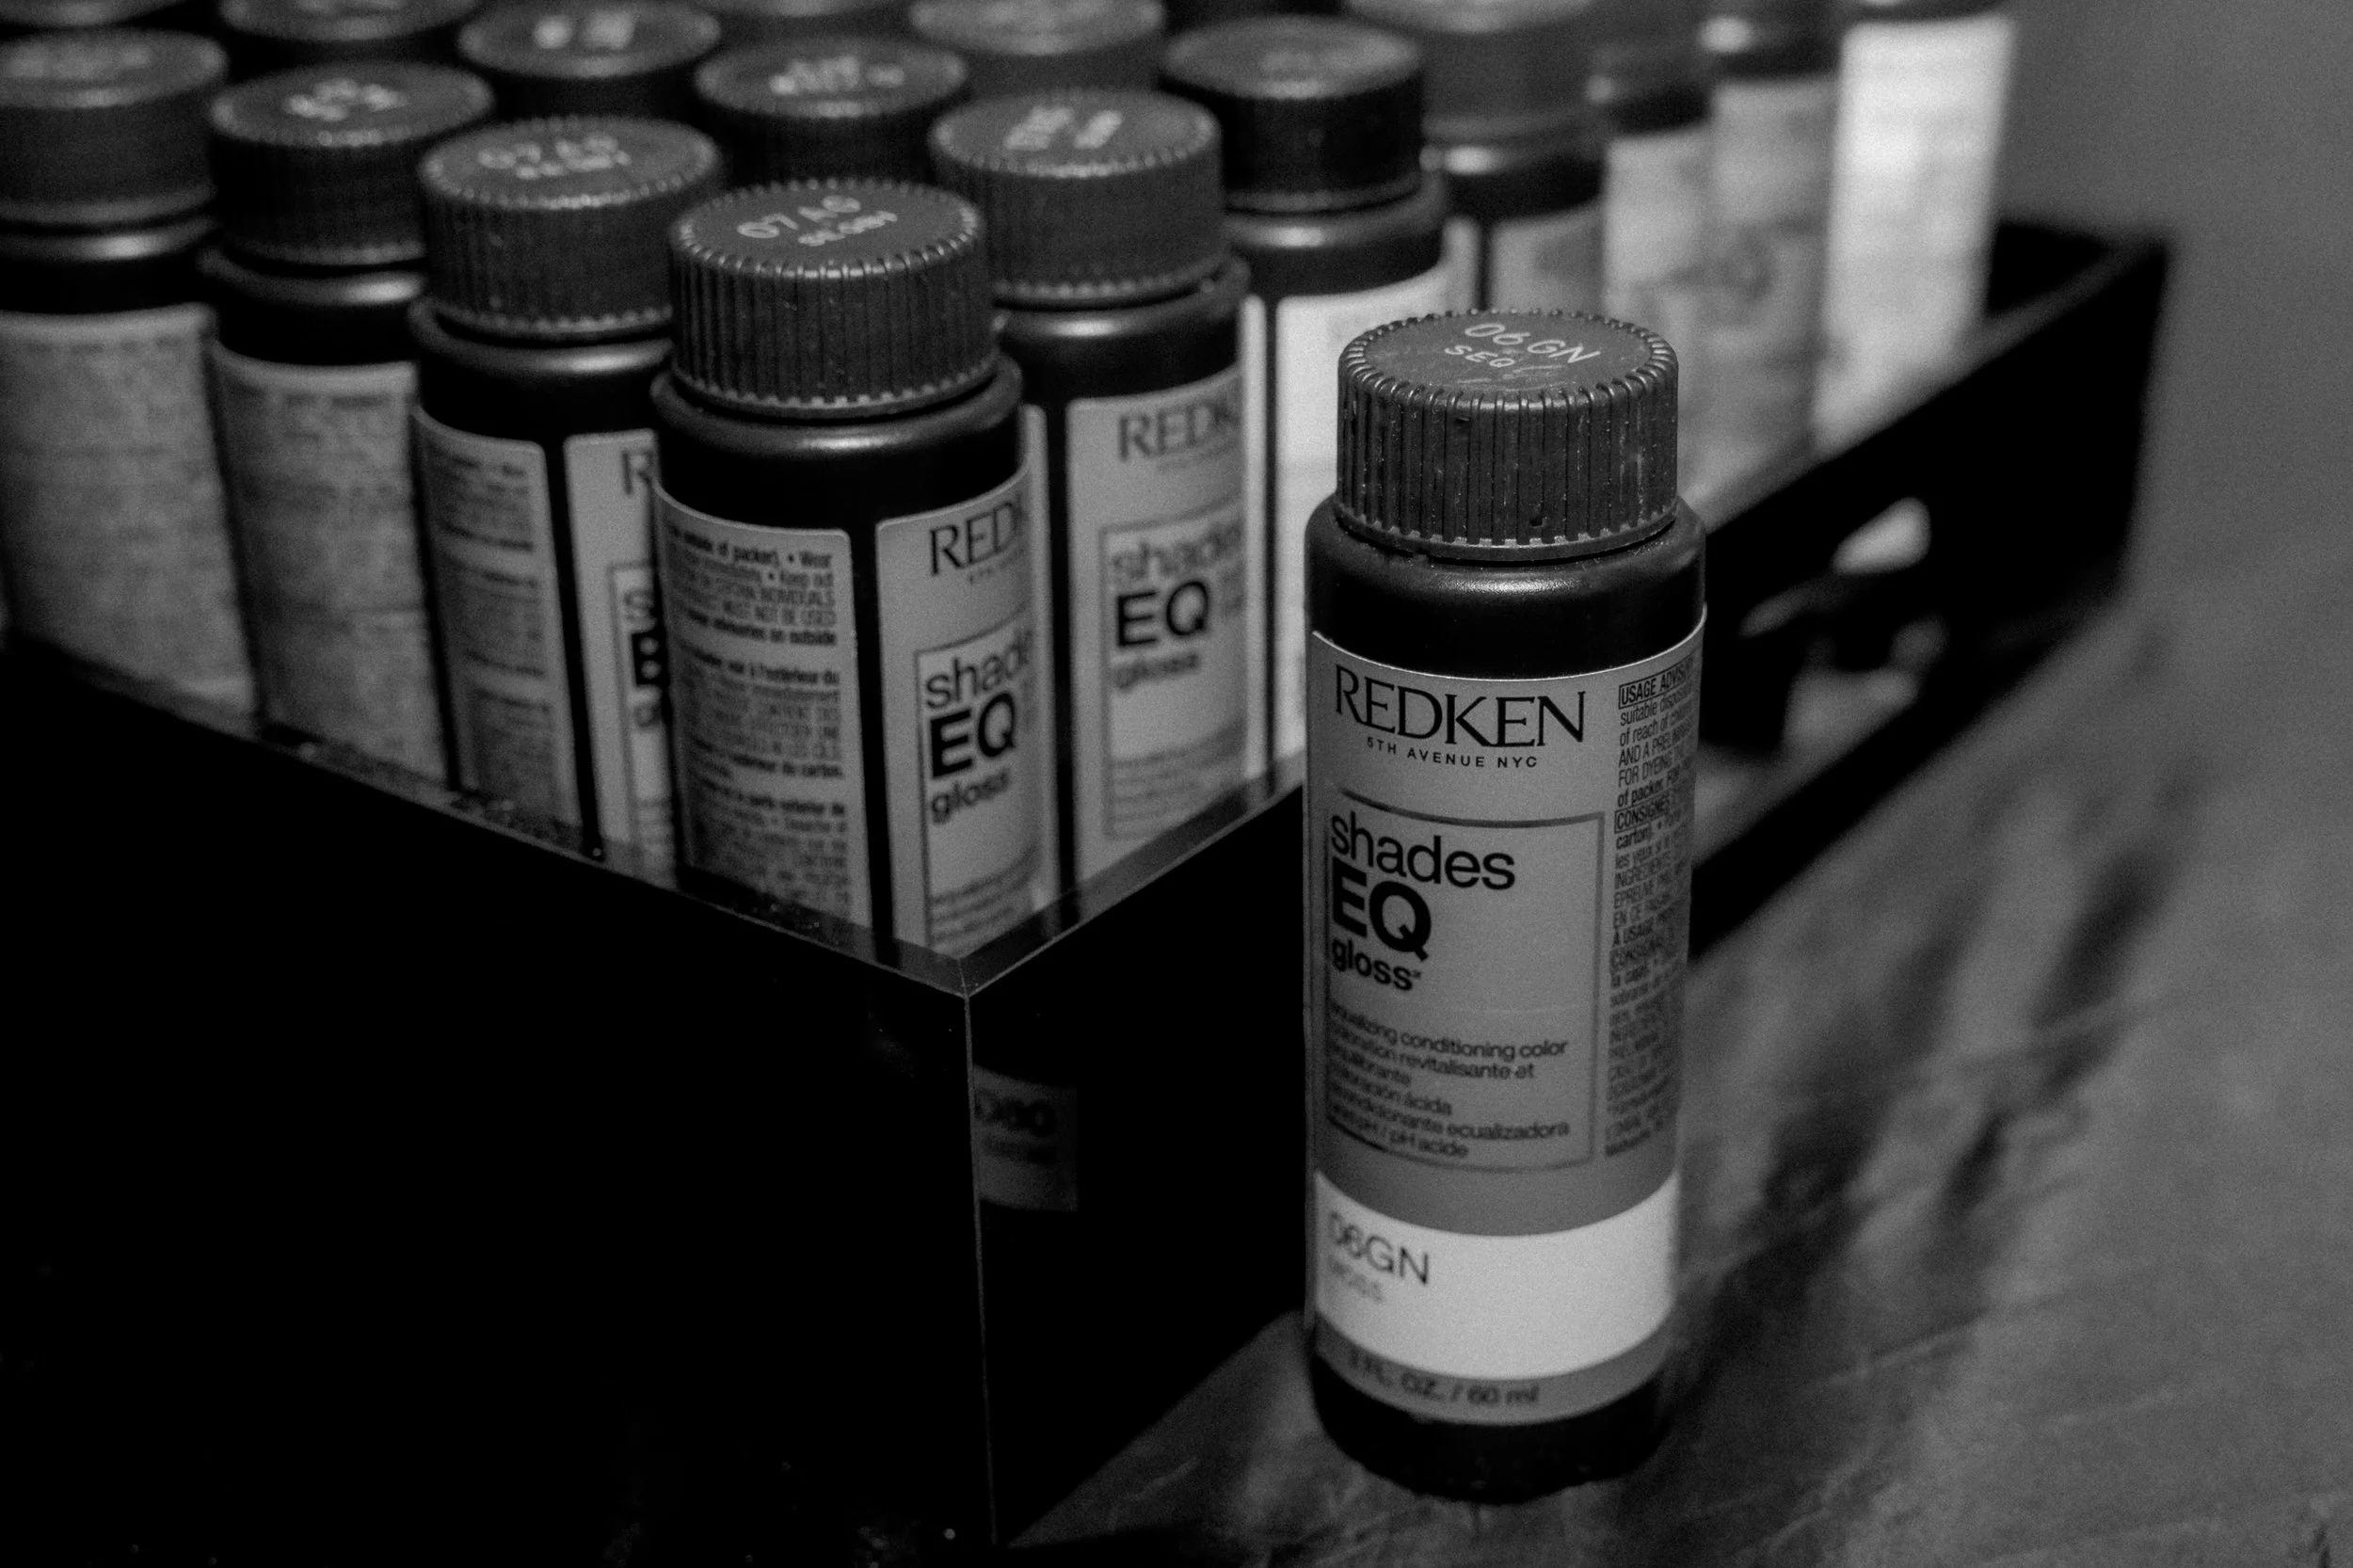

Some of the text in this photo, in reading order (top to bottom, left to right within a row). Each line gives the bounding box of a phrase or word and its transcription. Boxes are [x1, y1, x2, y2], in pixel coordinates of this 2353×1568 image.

[1443, 344, 1516, 369] SEQ
[1115, 577, 1212, 652] EQ
[1335, 663, 1587, 748] REDKEN
[1621, 677, 1657, 706] USAGE
[929, 689, 1017, 780] EQ
[1619, 726, 1630, 747] of
[1366, 735, 1539, 769] 5TH AVENUE NYC
[1618, 744, 1641, 768] AND
[1618, 765, 1640, 788] FOR
[1617, 789, 1629, 808] of
[1330, 810, 1516, 890] shades
[1332, 855, 1433, 962] EQ
[1400, 1032, 1515, 1063] conditioning
[1518, 1039, 1569, 1059] color
